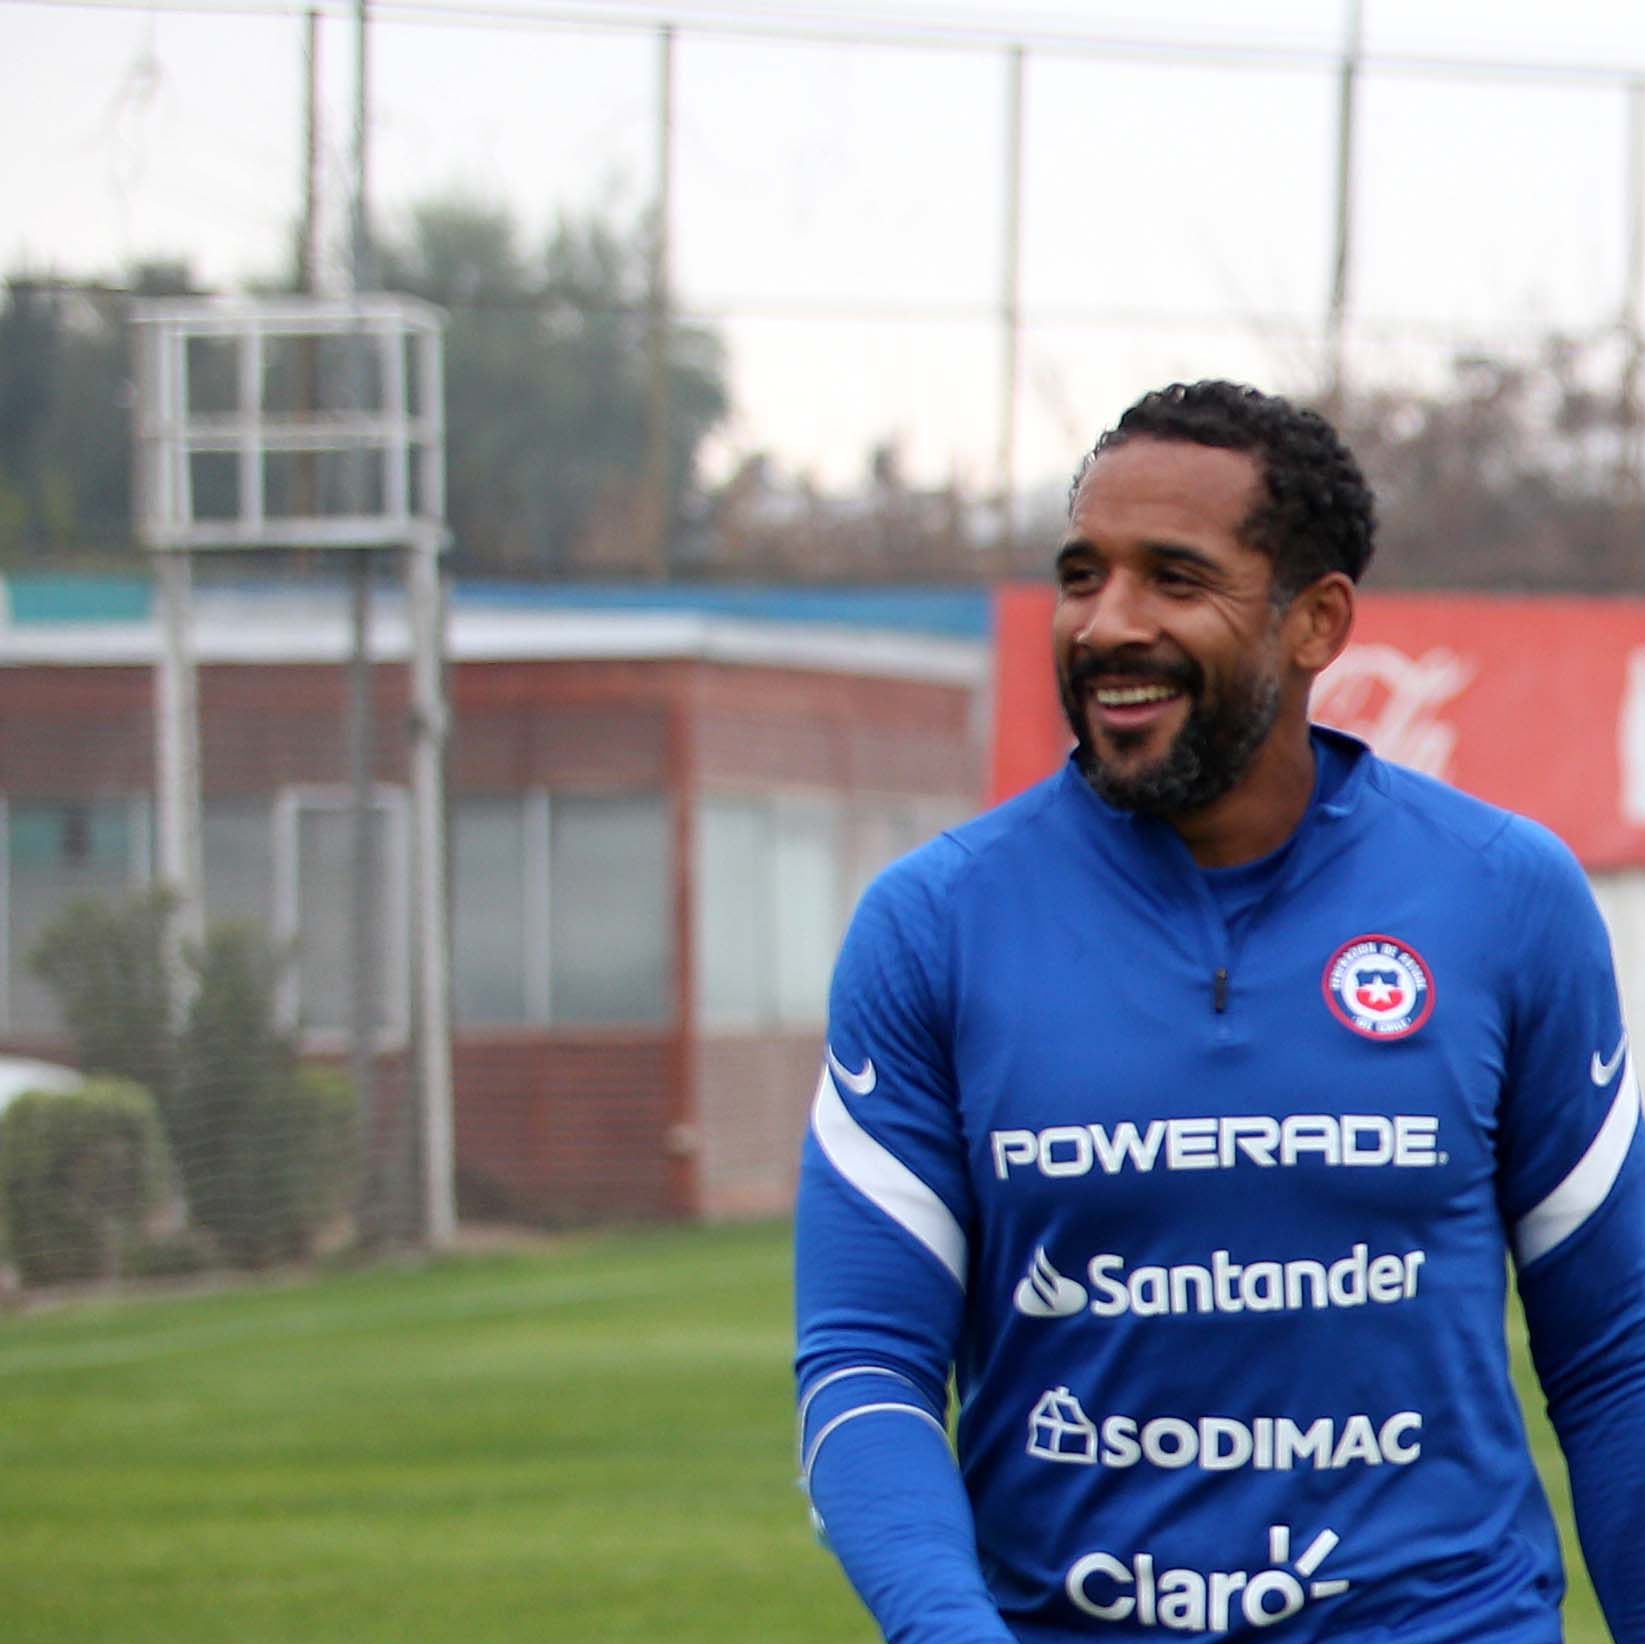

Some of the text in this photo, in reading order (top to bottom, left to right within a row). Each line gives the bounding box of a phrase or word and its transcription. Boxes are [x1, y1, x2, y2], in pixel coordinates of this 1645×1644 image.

[990, 1114, 1441, 1180] POWERADE
[1088, 1243, 1426, 1318] Santander
[1101, 1411, 1423, 1472] SODIMAC
[1065, 1550, 1305, 1633] Claro
